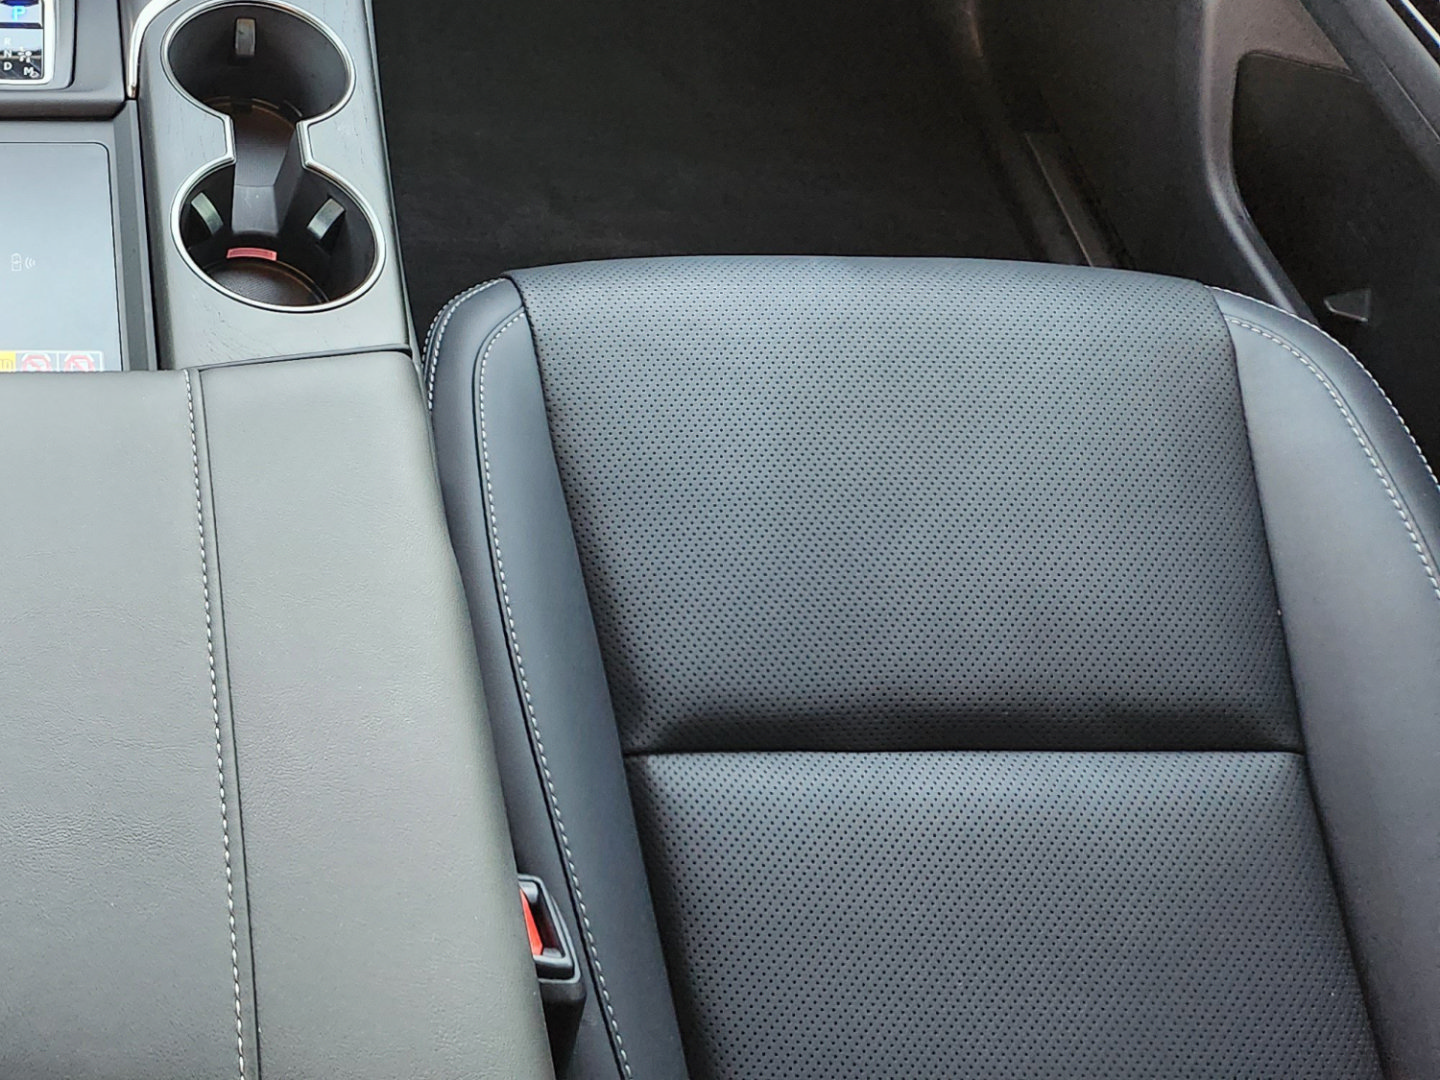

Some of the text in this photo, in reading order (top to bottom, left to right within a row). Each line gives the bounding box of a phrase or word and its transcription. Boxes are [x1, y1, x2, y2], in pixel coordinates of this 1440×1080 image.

[12, 5, 27, 21] P
[3, 49, 13, 58] N
[3, 61, 13, 71] D
